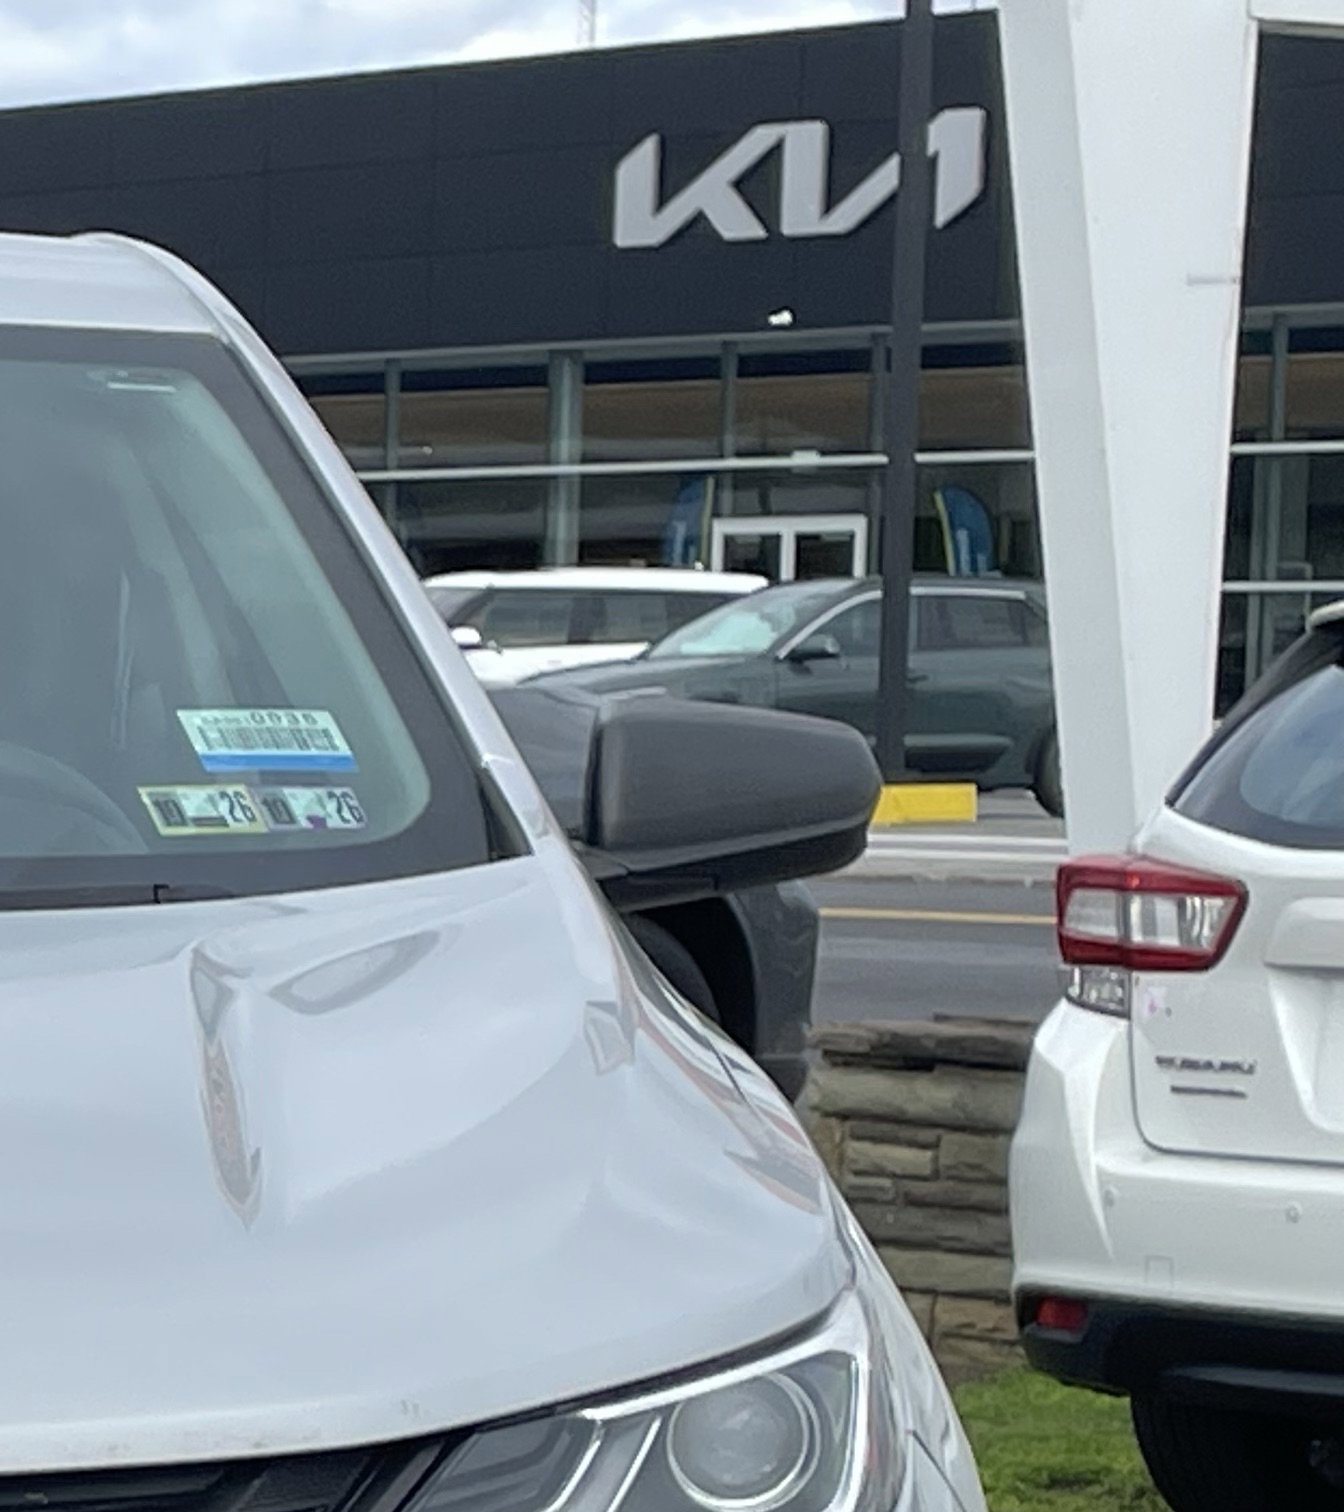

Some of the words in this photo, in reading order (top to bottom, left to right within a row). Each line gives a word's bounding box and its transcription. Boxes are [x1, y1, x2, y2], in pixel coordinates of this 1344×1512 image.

[613, 104, 987, 249] KIA
[219, 790, 257, 823] 26
[327, 791, 365, 824] 26
